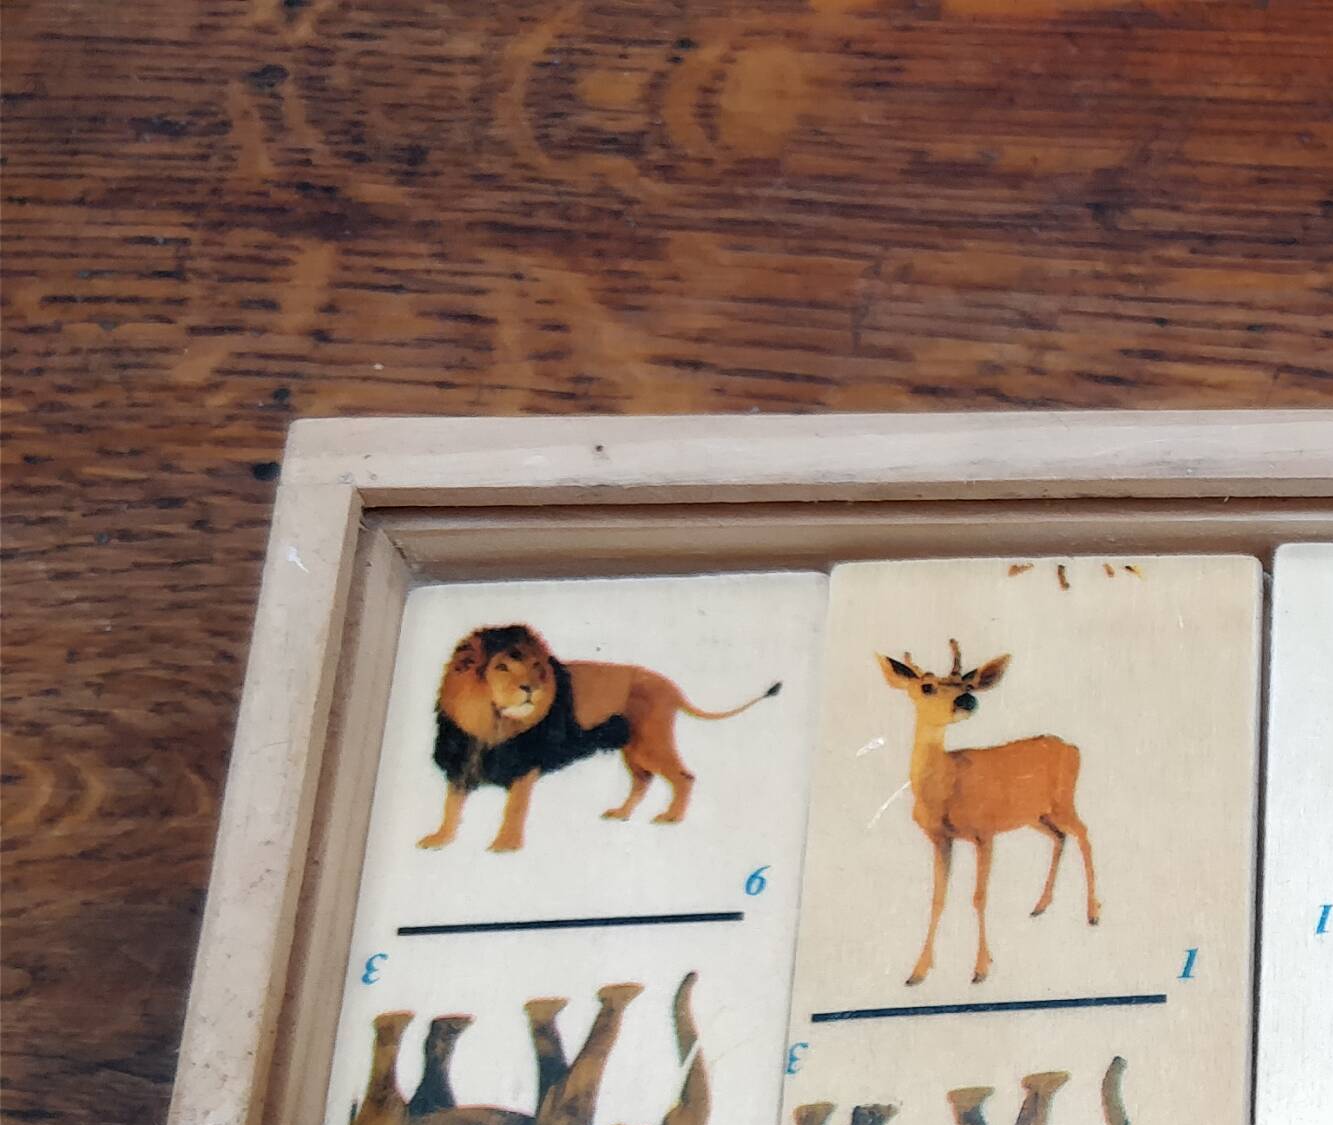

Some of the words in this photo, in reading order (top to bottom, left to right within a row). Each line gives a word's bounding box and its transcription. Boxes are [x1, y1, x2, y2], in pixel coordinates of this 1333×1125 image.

[744, 865, 771, 897] 6
[361, 952, 389, 986] 3
[1176, 947, 1200, 980] 1
[784, 1042, 809, 1076] 3
